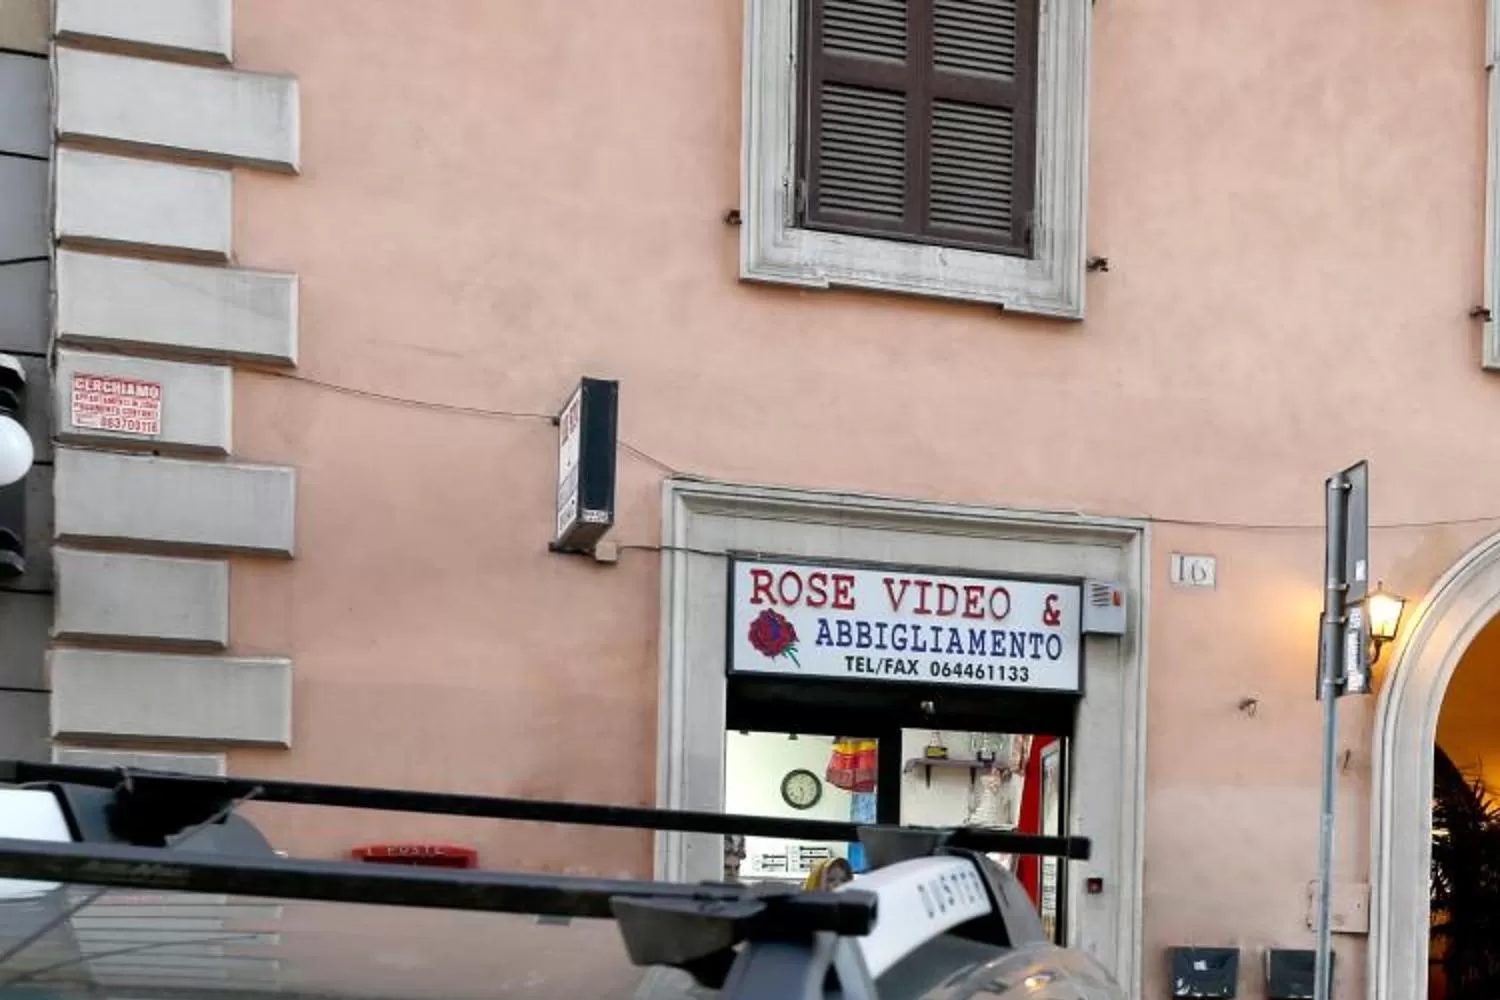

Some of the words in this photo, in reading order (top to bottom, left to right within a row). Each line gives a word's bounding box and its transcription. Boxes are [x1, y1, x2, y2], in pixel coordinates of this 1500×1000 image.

[75, 377, 160, 398] CERCHIAMO
[750, 569, 856, 611] ROSE
[884, 577, 1012, 621] VIDEO
[1042, 593, 1061, 627] &
[815, 617, 1062, 660] ABBIGLIAMENTO
[845, 655, 920, 677] TEL/FAX
[930, 661, 1030, 683] 064461133
